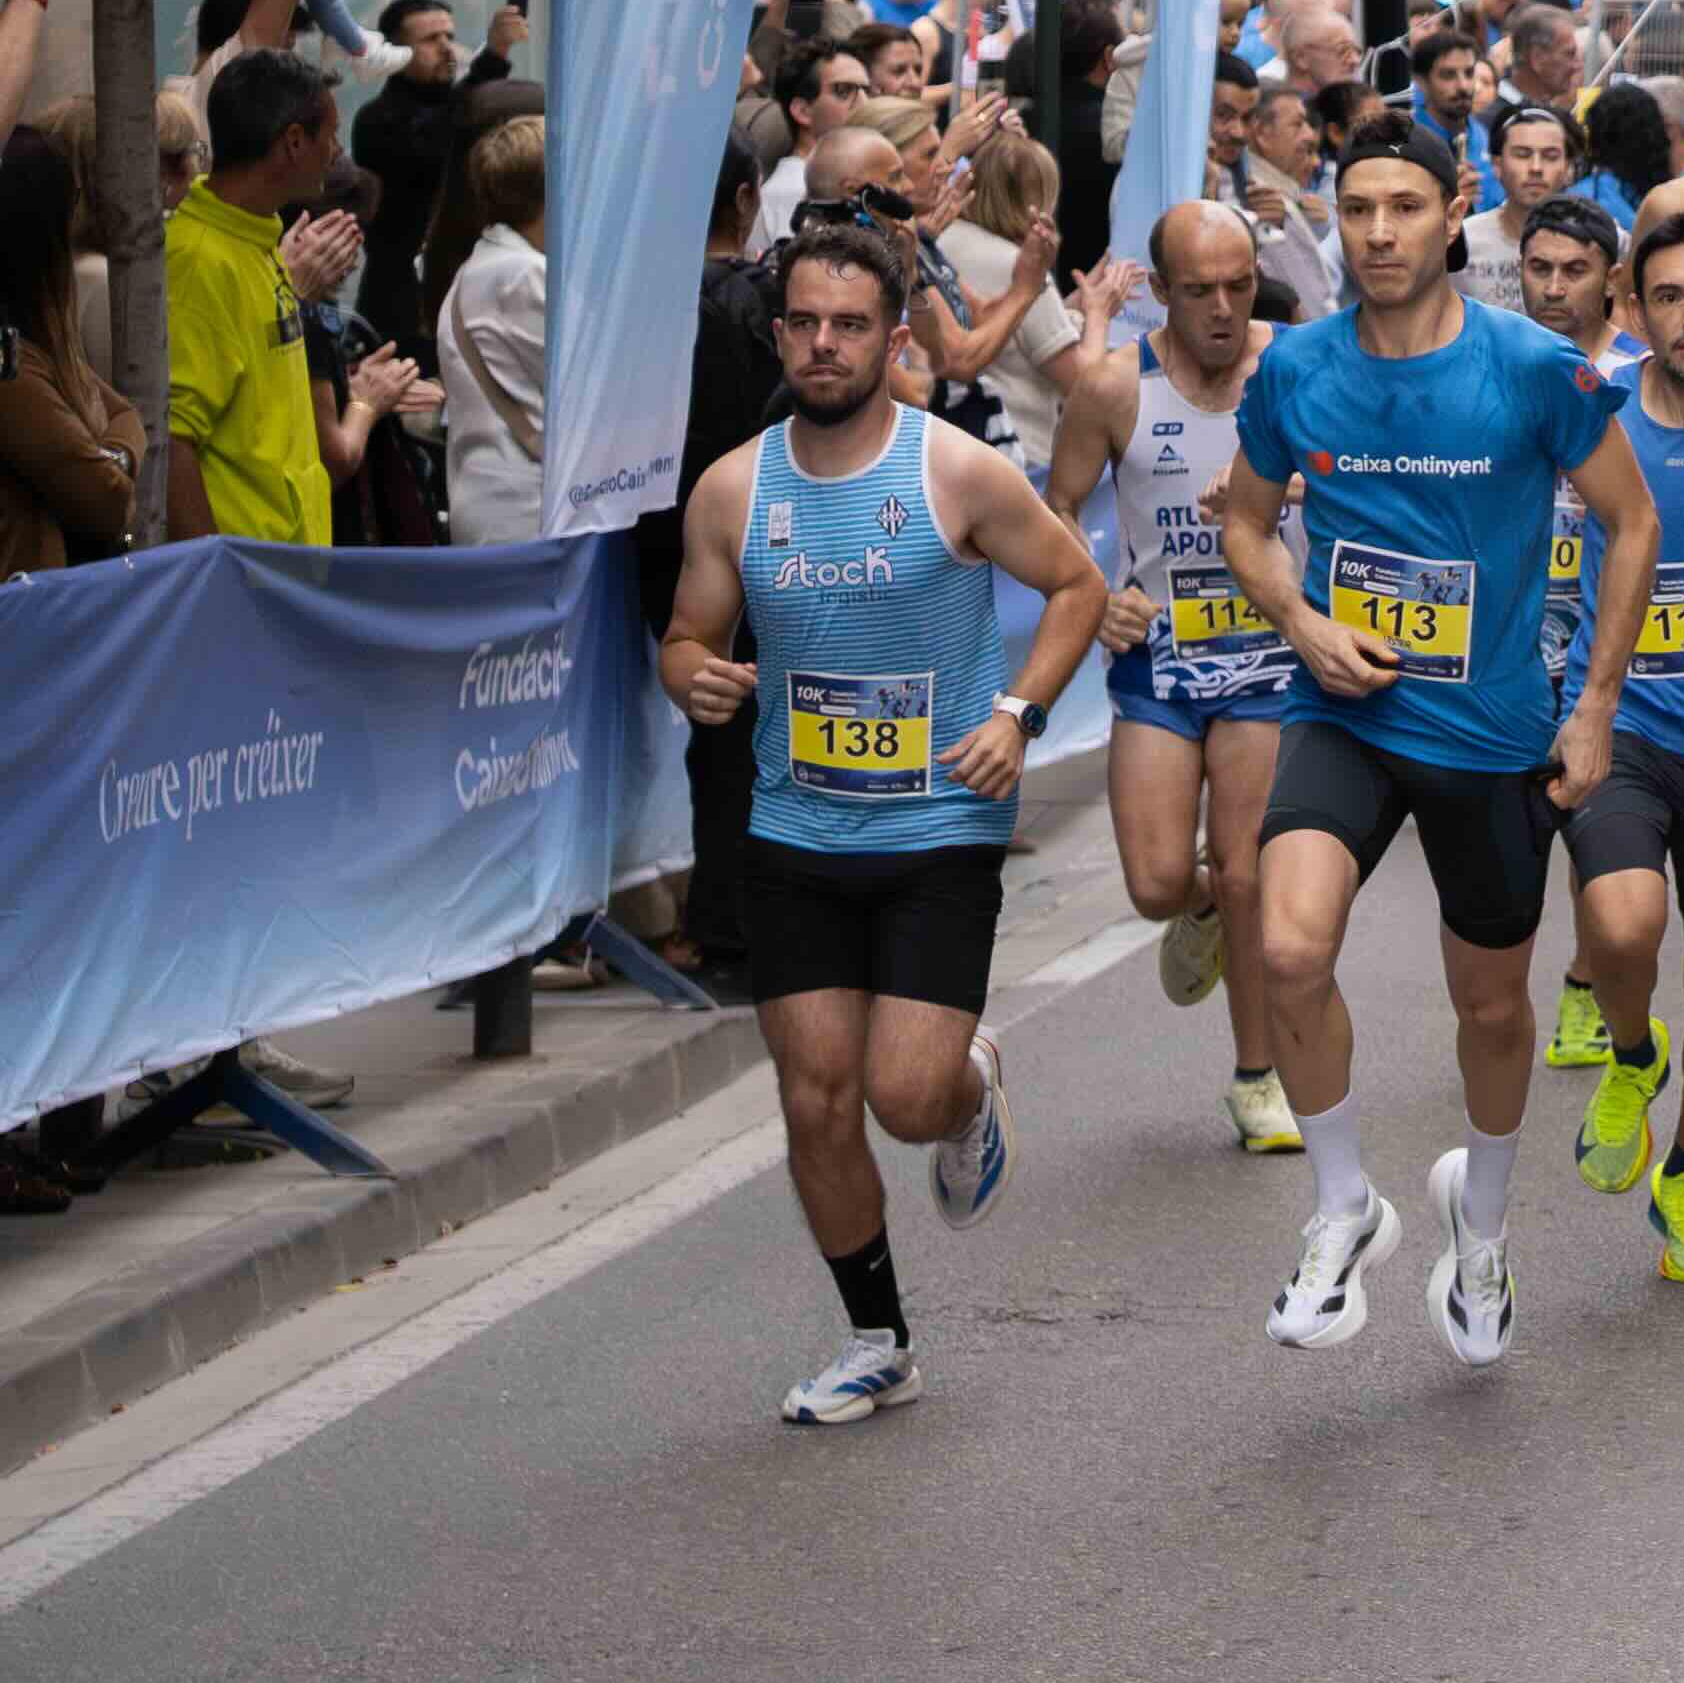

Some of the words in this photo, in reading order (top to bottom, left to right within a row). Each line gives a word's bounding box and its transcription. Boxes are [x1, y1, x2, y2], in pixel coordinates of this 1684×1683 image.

[1337, 454, 1391, 473] Caixa
[1395, 455, 1492, 478] Ontinyent
[1340, 560, 1371, 579] 10K
[1361, 597, 1438, 642] 113
[797, 685, 826, 702] 10K
[819, 719, 899, 758] 138
[186, 748, 228, 842] per
